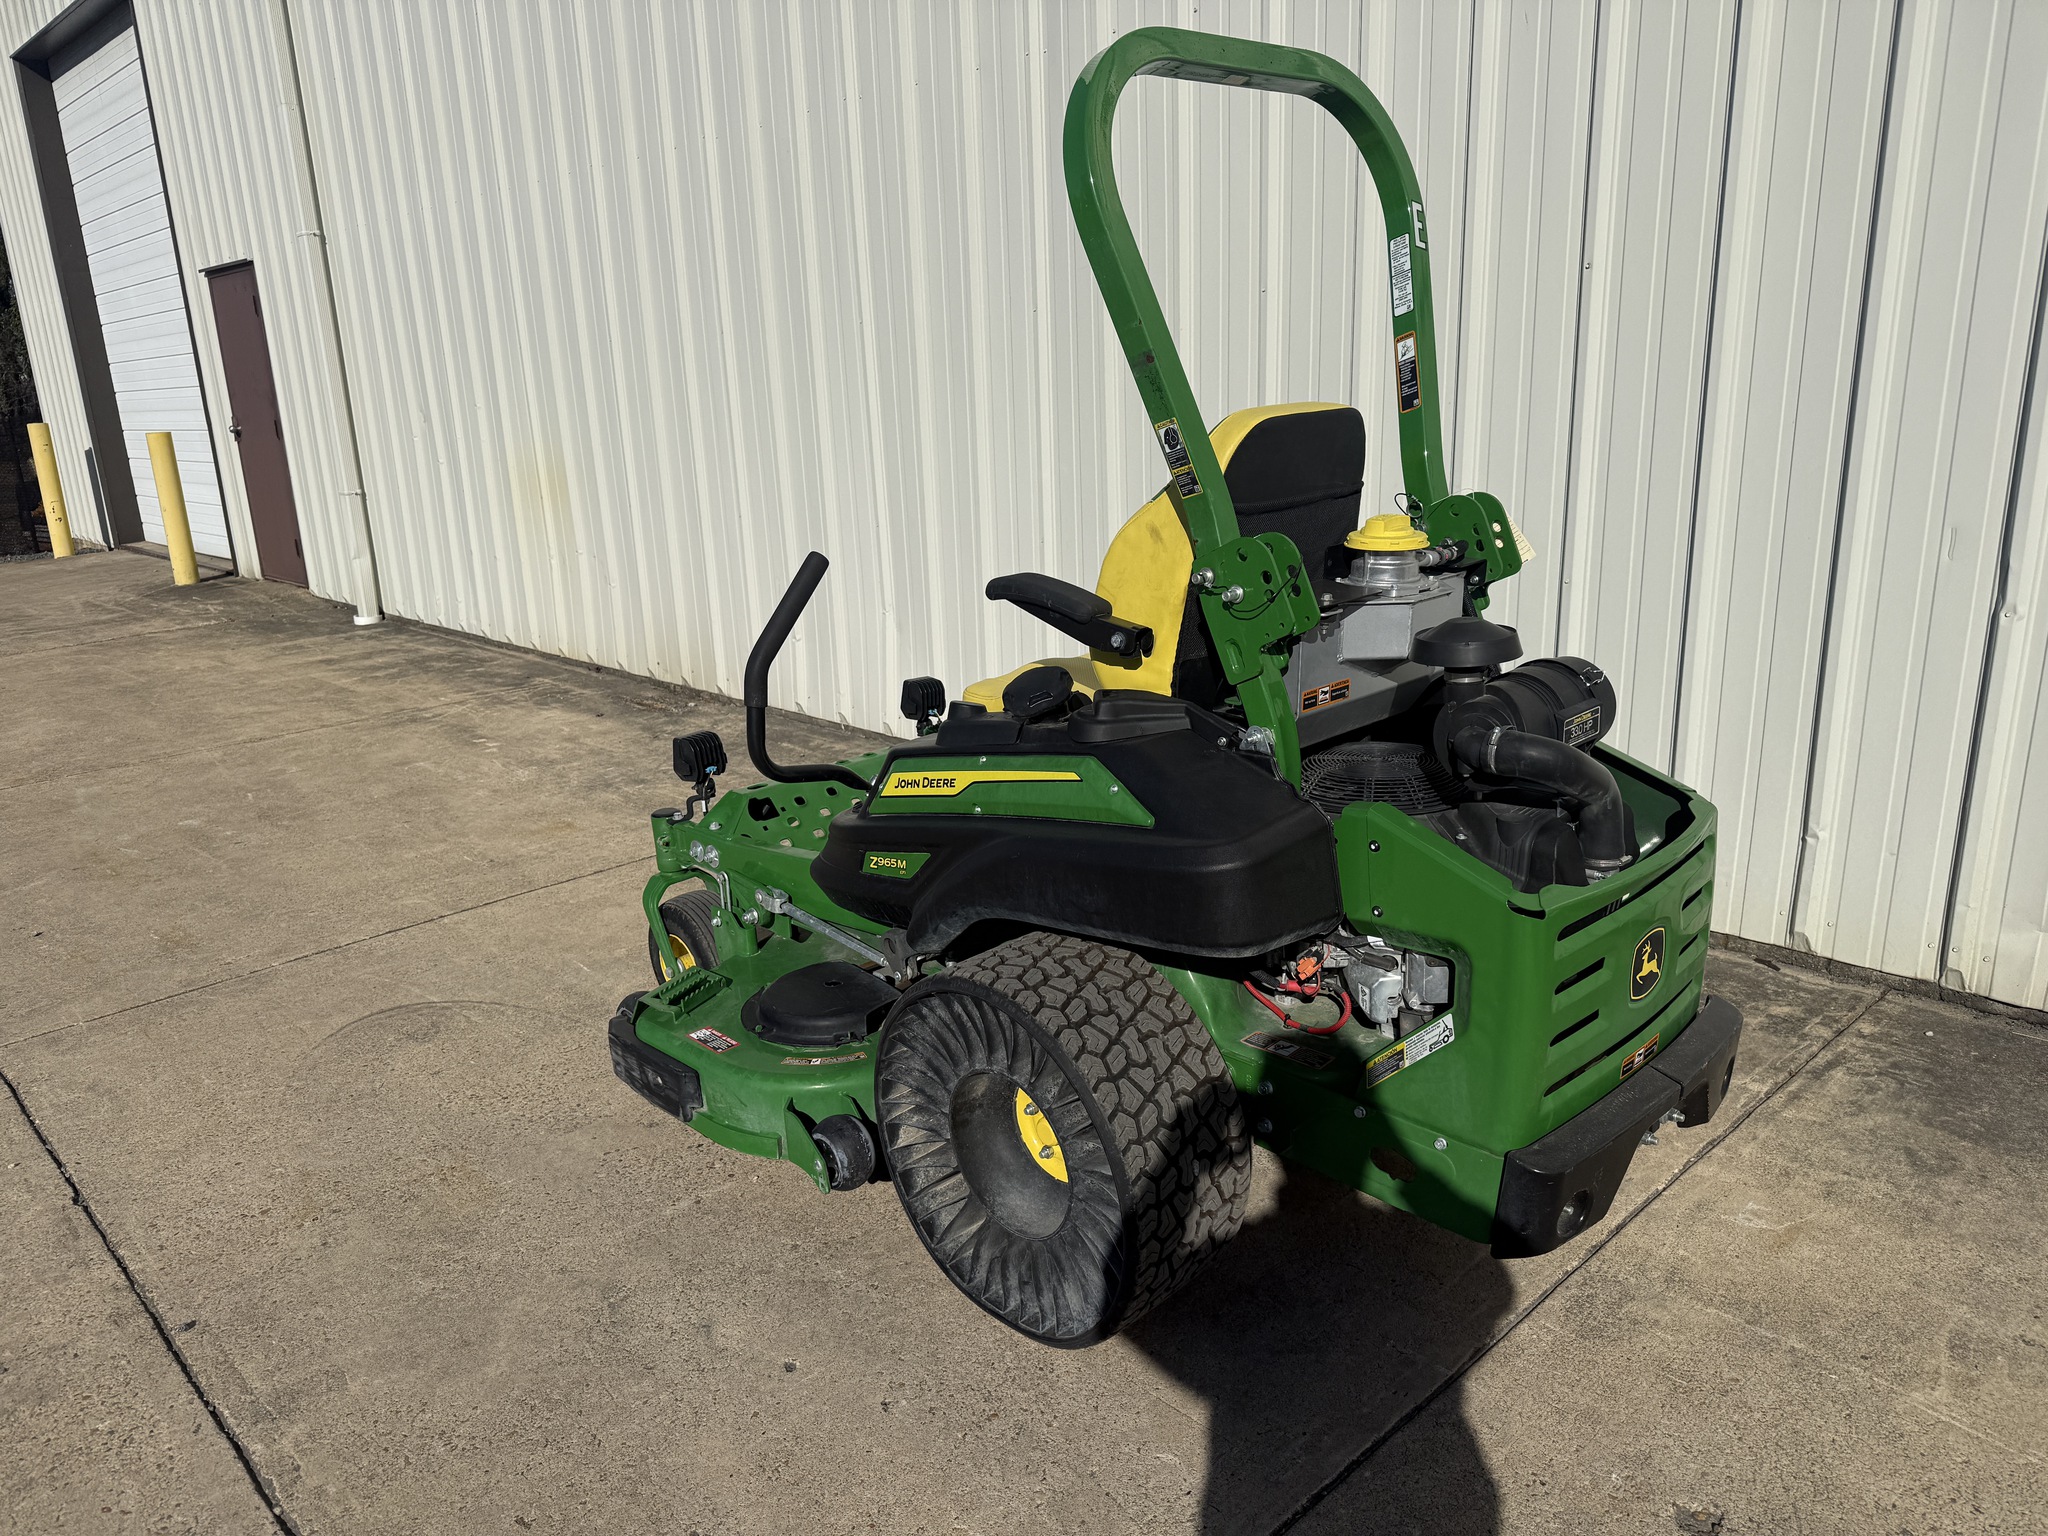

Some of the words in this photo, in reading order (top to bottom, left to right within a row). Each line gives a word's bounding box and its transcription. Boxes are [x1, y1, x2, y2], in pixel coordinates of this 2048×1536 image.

[1411, 200, 1427, 250] E
[1583, 719, 1593, 733] HP
[894, 777, 921, 789] JOHN
[922, 776, 957, 789] DEERE
[869, 856, 907, 869] Z965M
